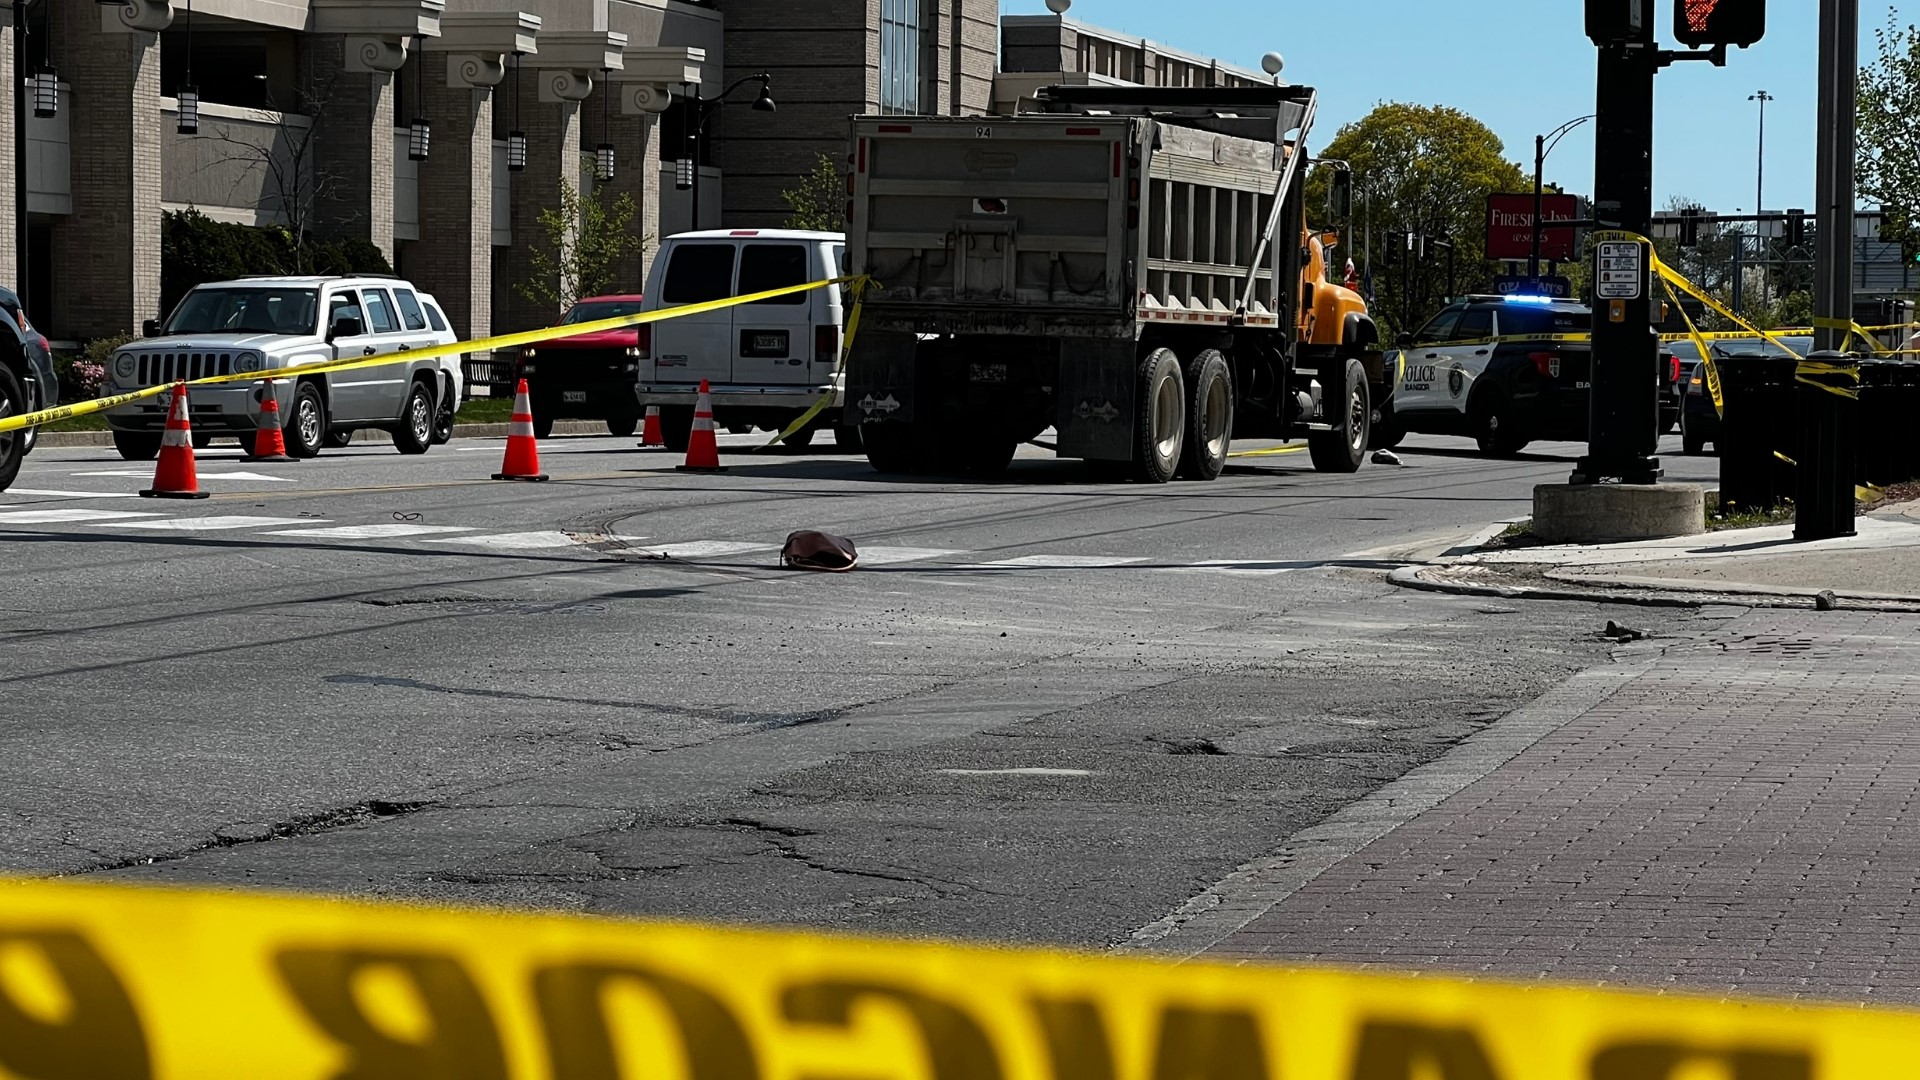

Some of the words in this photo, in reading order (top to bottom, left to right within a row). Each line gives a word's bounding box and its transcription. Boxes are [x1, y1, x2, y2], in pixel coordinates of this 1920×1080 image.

[976, 126, 991, 138] 94
[1491, 208, 1546, 227] FIRESIE
[1404, 383, 1431, 392] BANGOR
